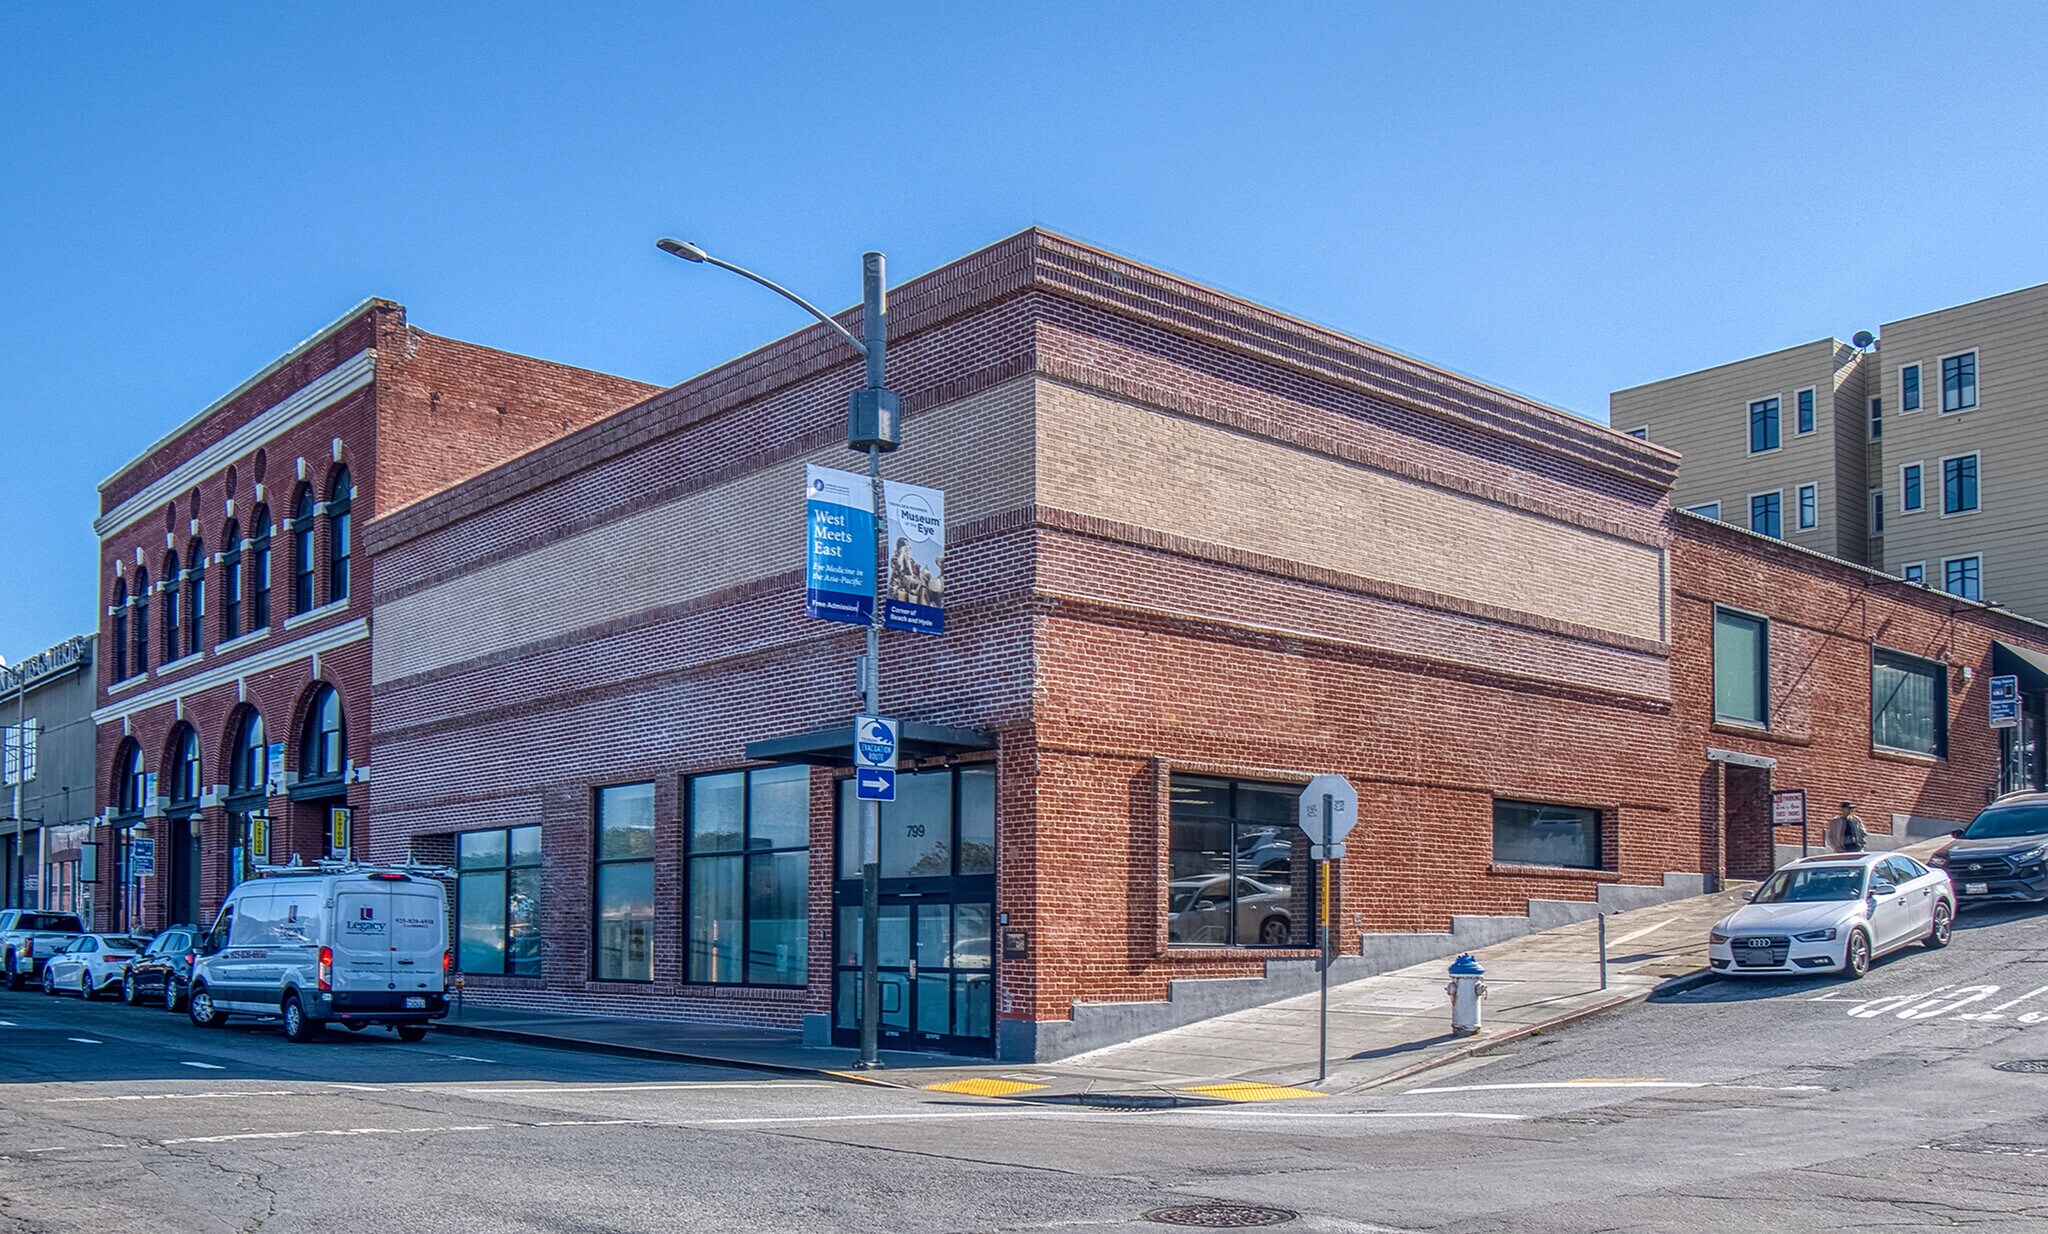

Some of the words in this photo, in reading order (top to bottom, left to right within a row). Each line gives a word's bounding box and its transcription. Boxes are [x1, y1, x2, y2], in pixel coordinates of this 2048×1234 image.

[814, 509, 845, 526] West
[901, 510, 940, 526] Museum
[814, 525, 852, 543] Meets
[918, 524, 934, 536] Eye
[814, 541, 842, 557] East
[813, 562, 824, 571] Eye
[826, 565, 855, 575] Medicine
[813, 572, 823, 580] the
[824, 575, 862, 586] Asia-Pacific
[812, 600, 826, 608] Free
[827, 602, 858, 612] Admission
[891, 606, 909, 615] Corner
[890, 614, 908, 622] Beach
[919, 618, 933, 626] Hyde
[862, 743, 891, 754] EVACUATION
[868, 752, 884, 761] ROUTE
[906, 825, 925, 837] 799
[346, 921, 386, 932] Legacy
